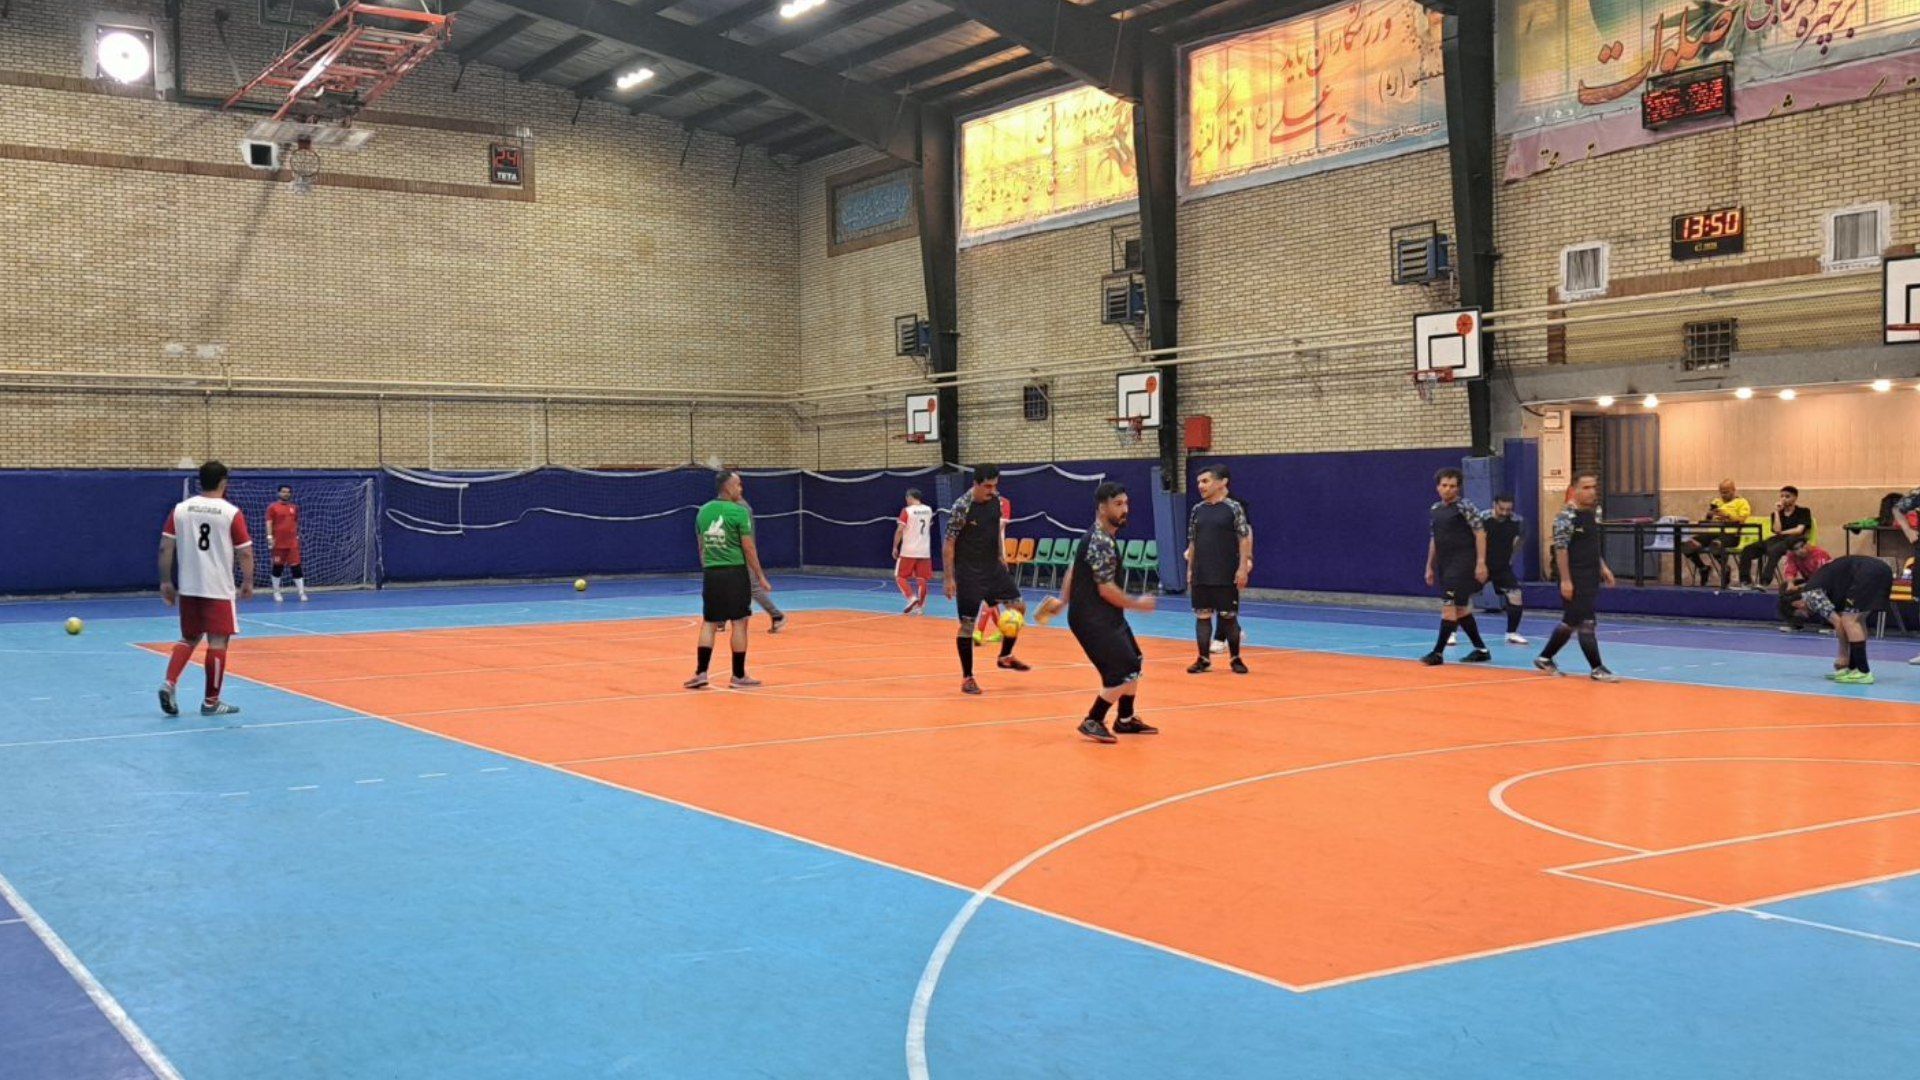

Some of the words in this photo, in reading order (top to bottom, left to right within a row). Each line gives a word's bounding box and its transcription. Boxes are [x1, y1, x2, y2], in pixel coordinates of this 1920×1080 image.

[1577, 6, 1738, 106] صلوات
[1683, 211, 1739, 240] 13:50
[198, 523, 210, 550] 8
[920, 519, 926, 535] 7
